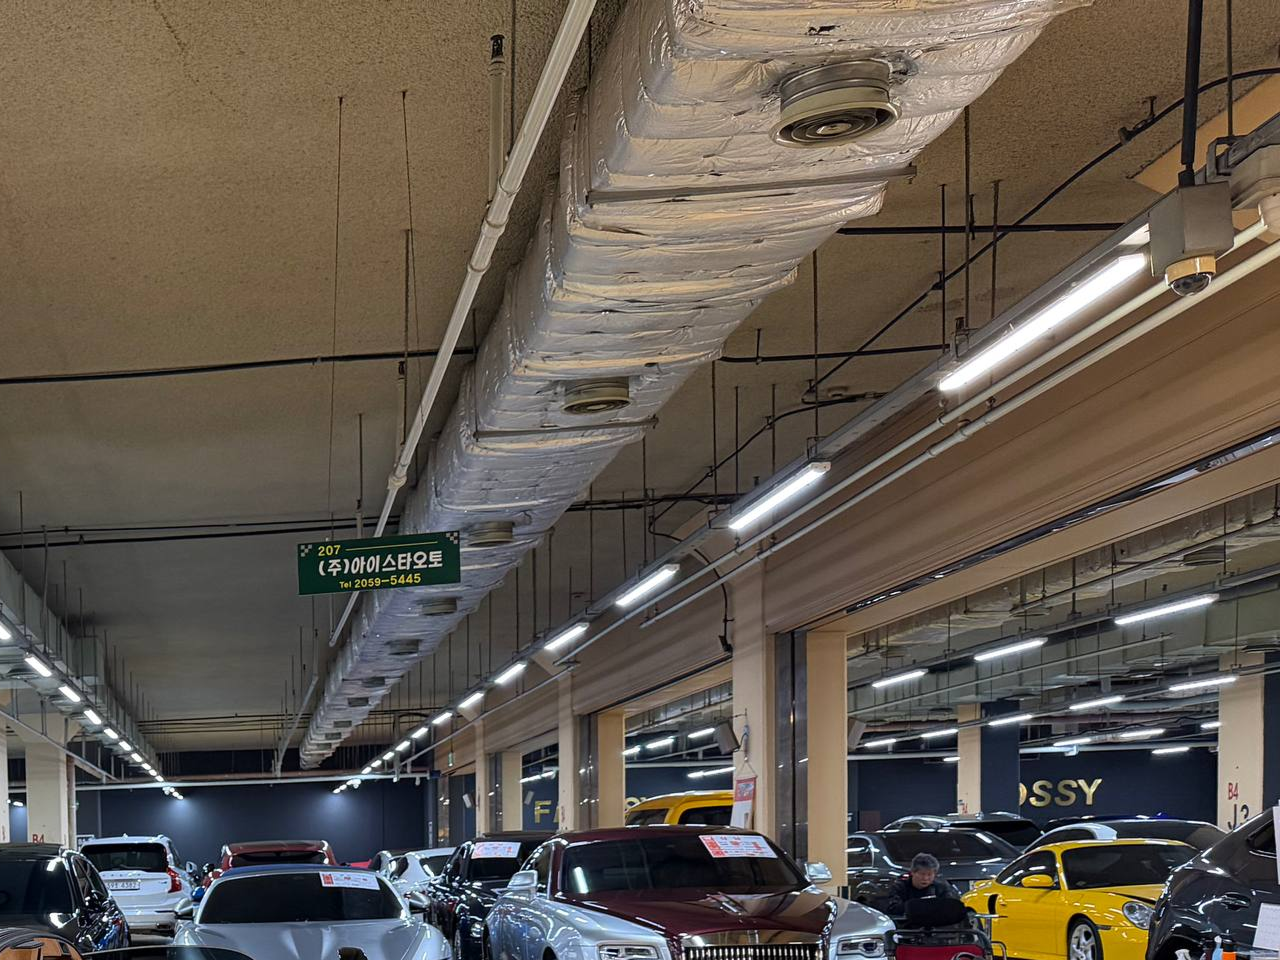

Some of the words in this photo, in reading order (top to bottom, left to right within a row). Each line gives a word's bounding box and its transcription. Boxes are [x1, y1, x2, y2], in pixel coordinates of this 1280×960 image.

[318, 545, 341, 557] 207
[318, 550, 443, 577] (주)아이스타오토
[339, 581, 352, 589] Tel
[354, 573, 422, 588] 2059-5445
[1228, 782, 1238, 800] B4
